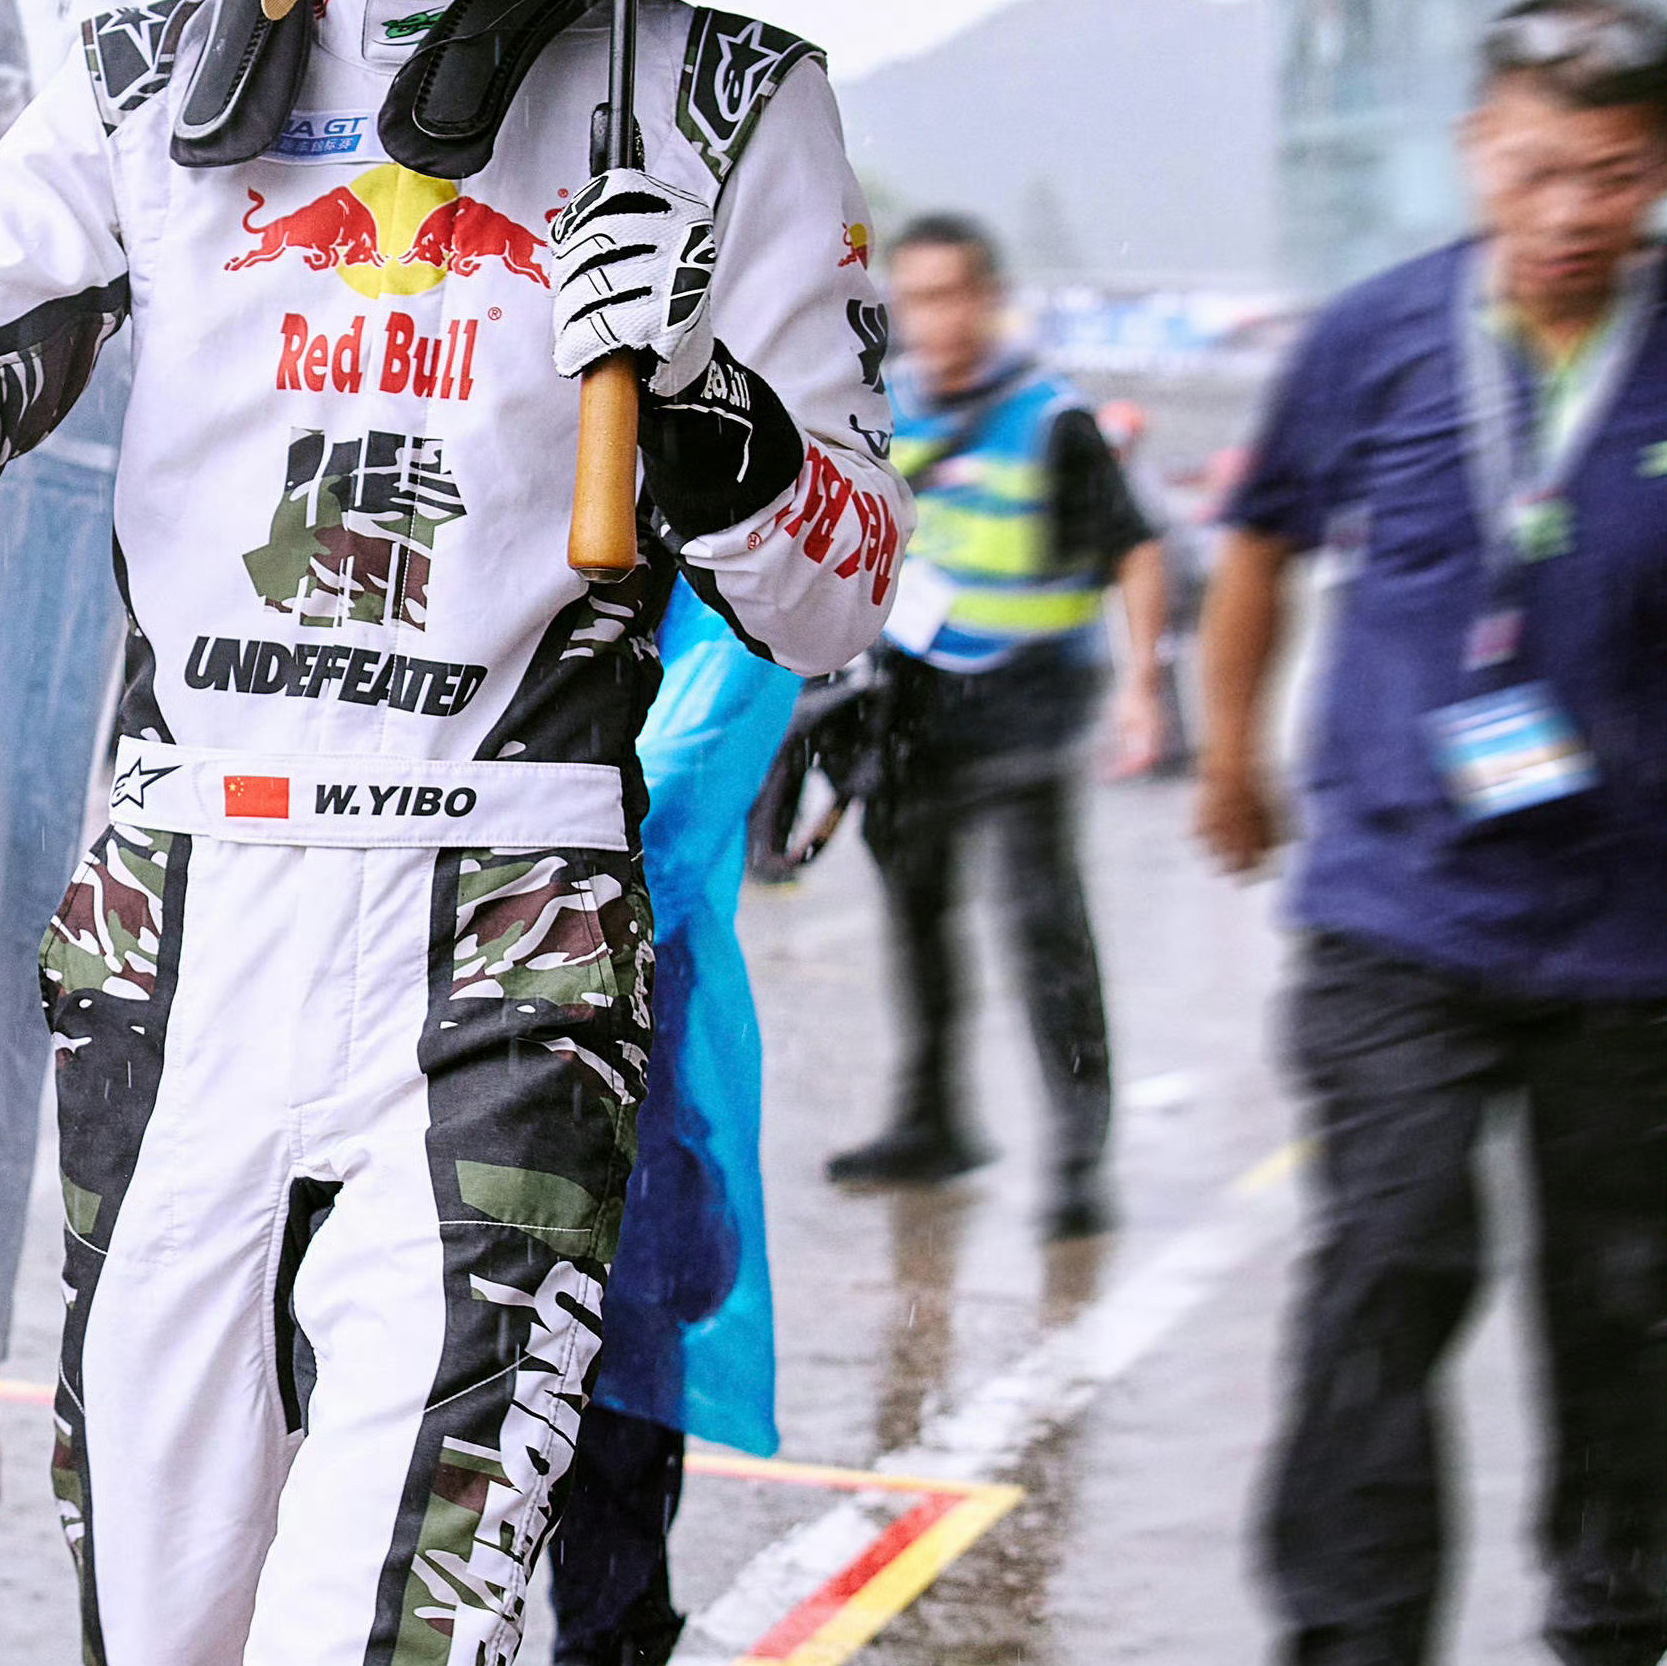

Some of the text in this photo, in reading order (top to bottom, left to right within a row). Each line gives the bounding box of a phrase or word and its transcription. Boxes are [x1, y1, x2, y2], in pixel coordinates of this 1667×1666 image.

[323, 117, 369, 135] GT
[276, 311, 479, 401] Red Bull
[183, 635, 488, 717] UNDEFEATED
[314, 783, 477, 818] W.YIBO
